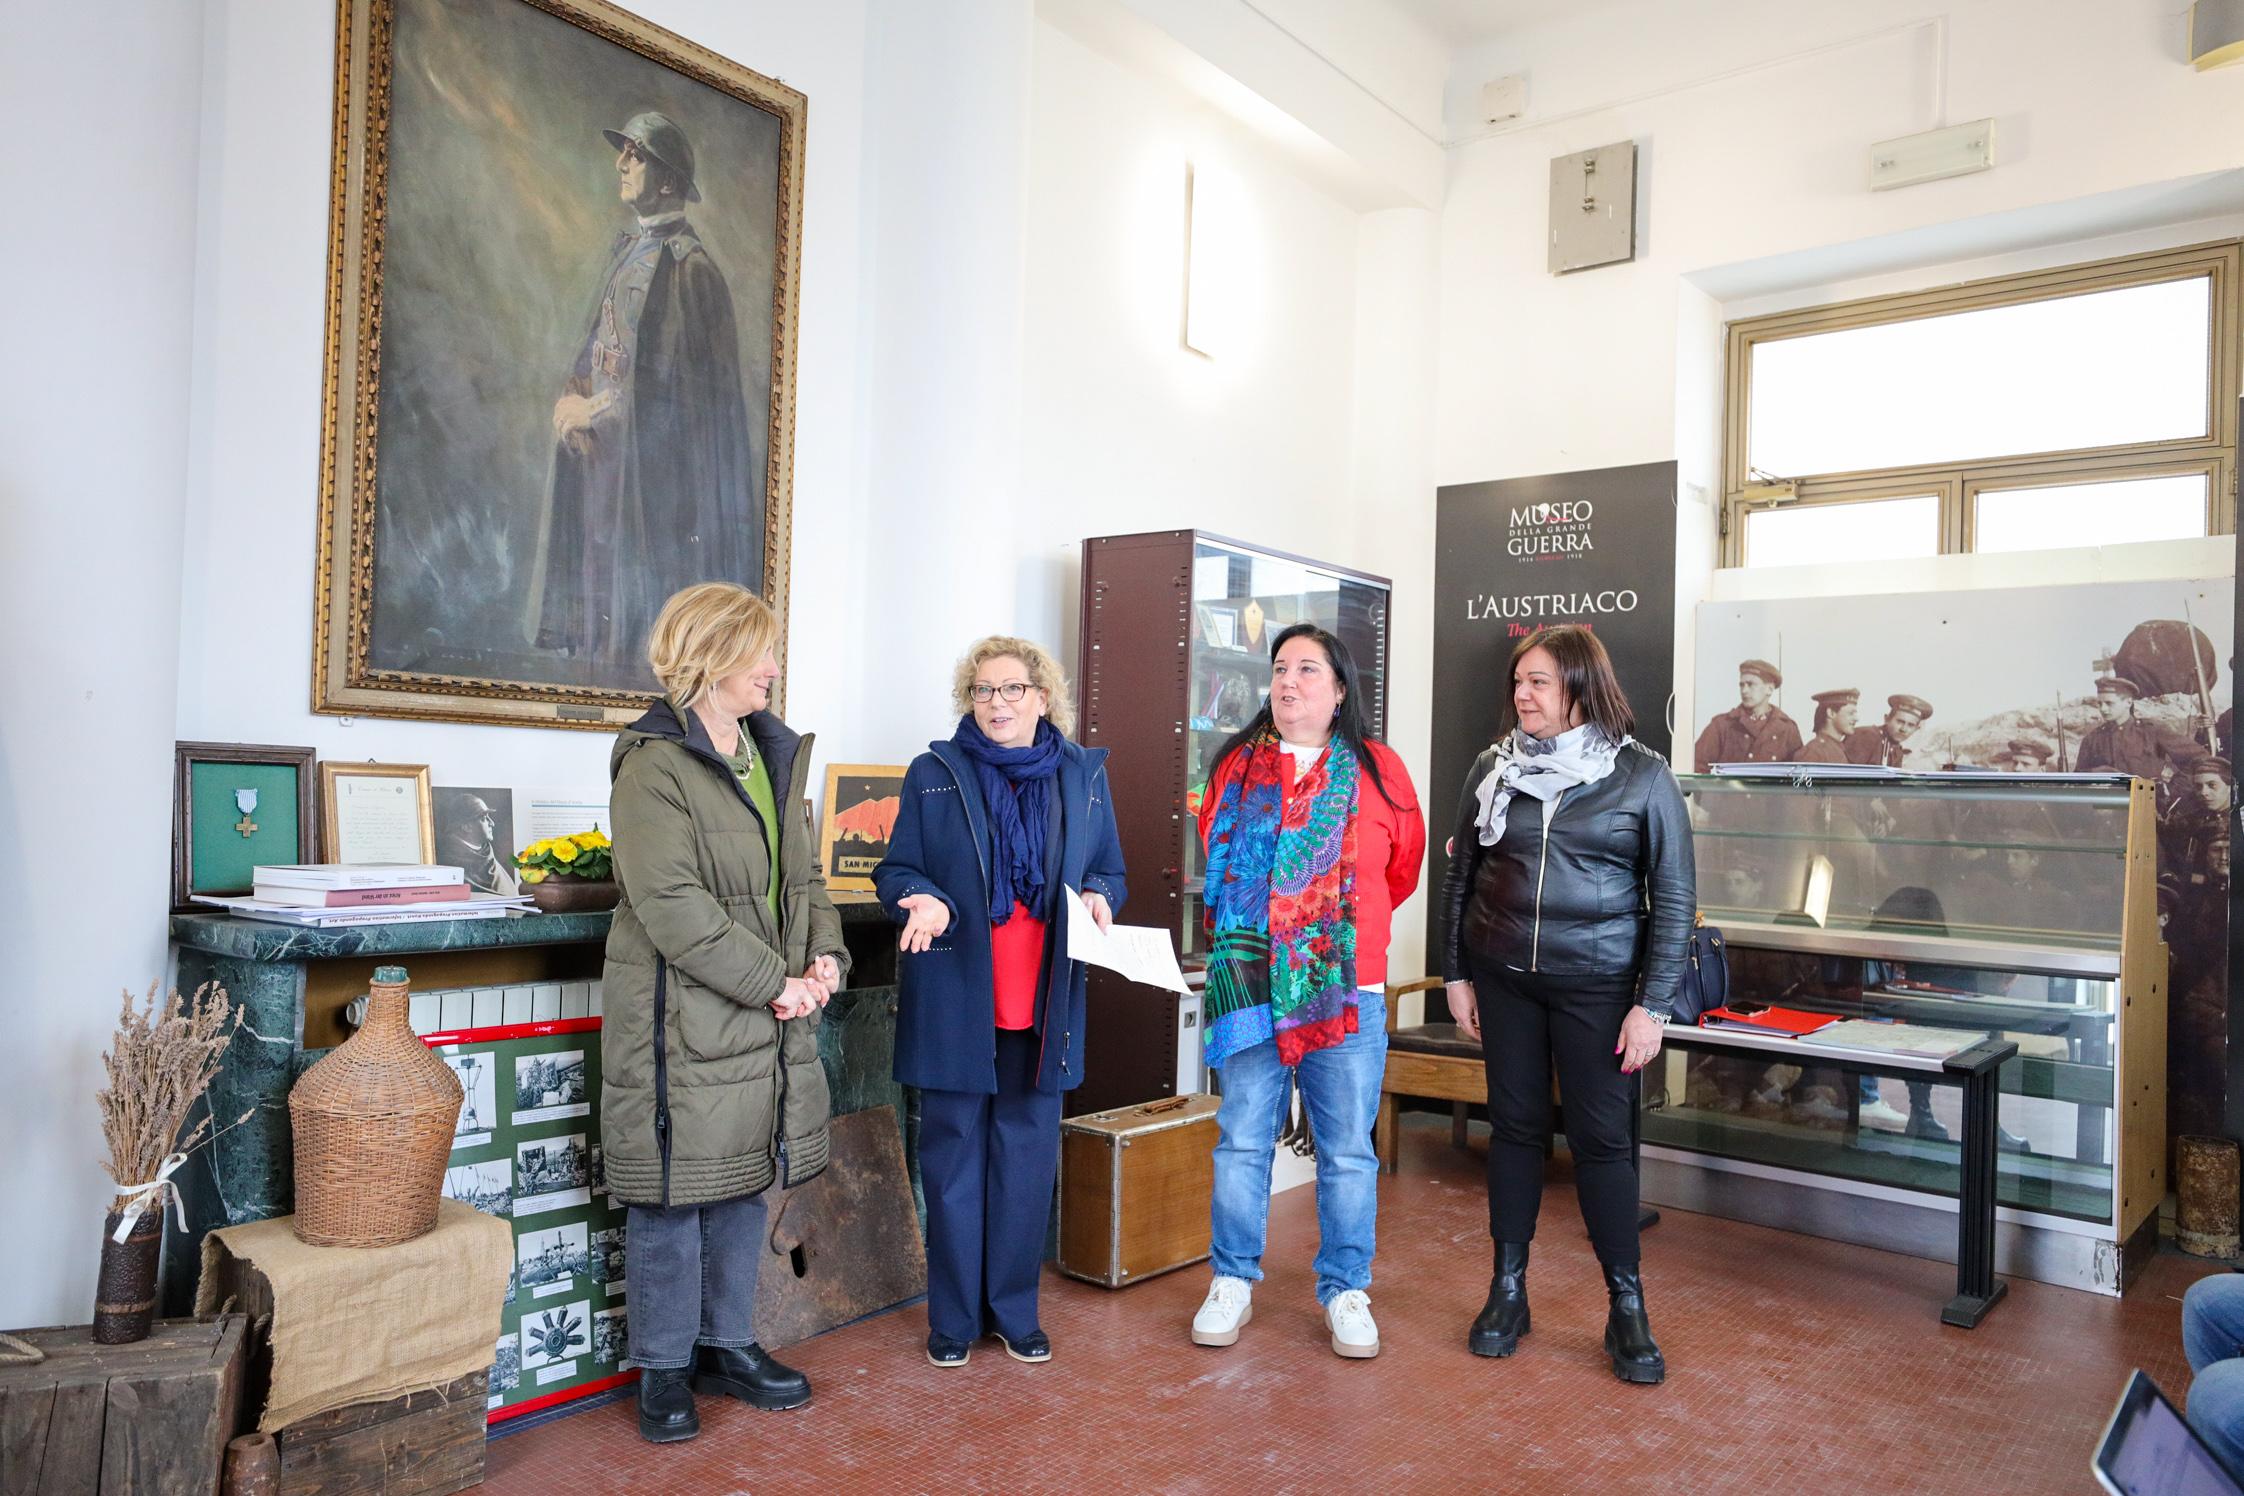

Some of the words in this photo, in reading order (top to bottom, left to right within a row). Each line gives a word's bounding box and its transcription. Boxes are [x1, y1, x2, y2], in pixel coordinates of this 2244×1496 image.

[1509, 500, 1593, 527] MUSEO
[1509, 528, 1541, 537] DELLA
[1547, 523, 1592, 534] GRANDE
[1507, 532, 1594, 556] GUERRA
[1507, 623, 1532, 638] The
[844, 860, 860, 868] SAN
